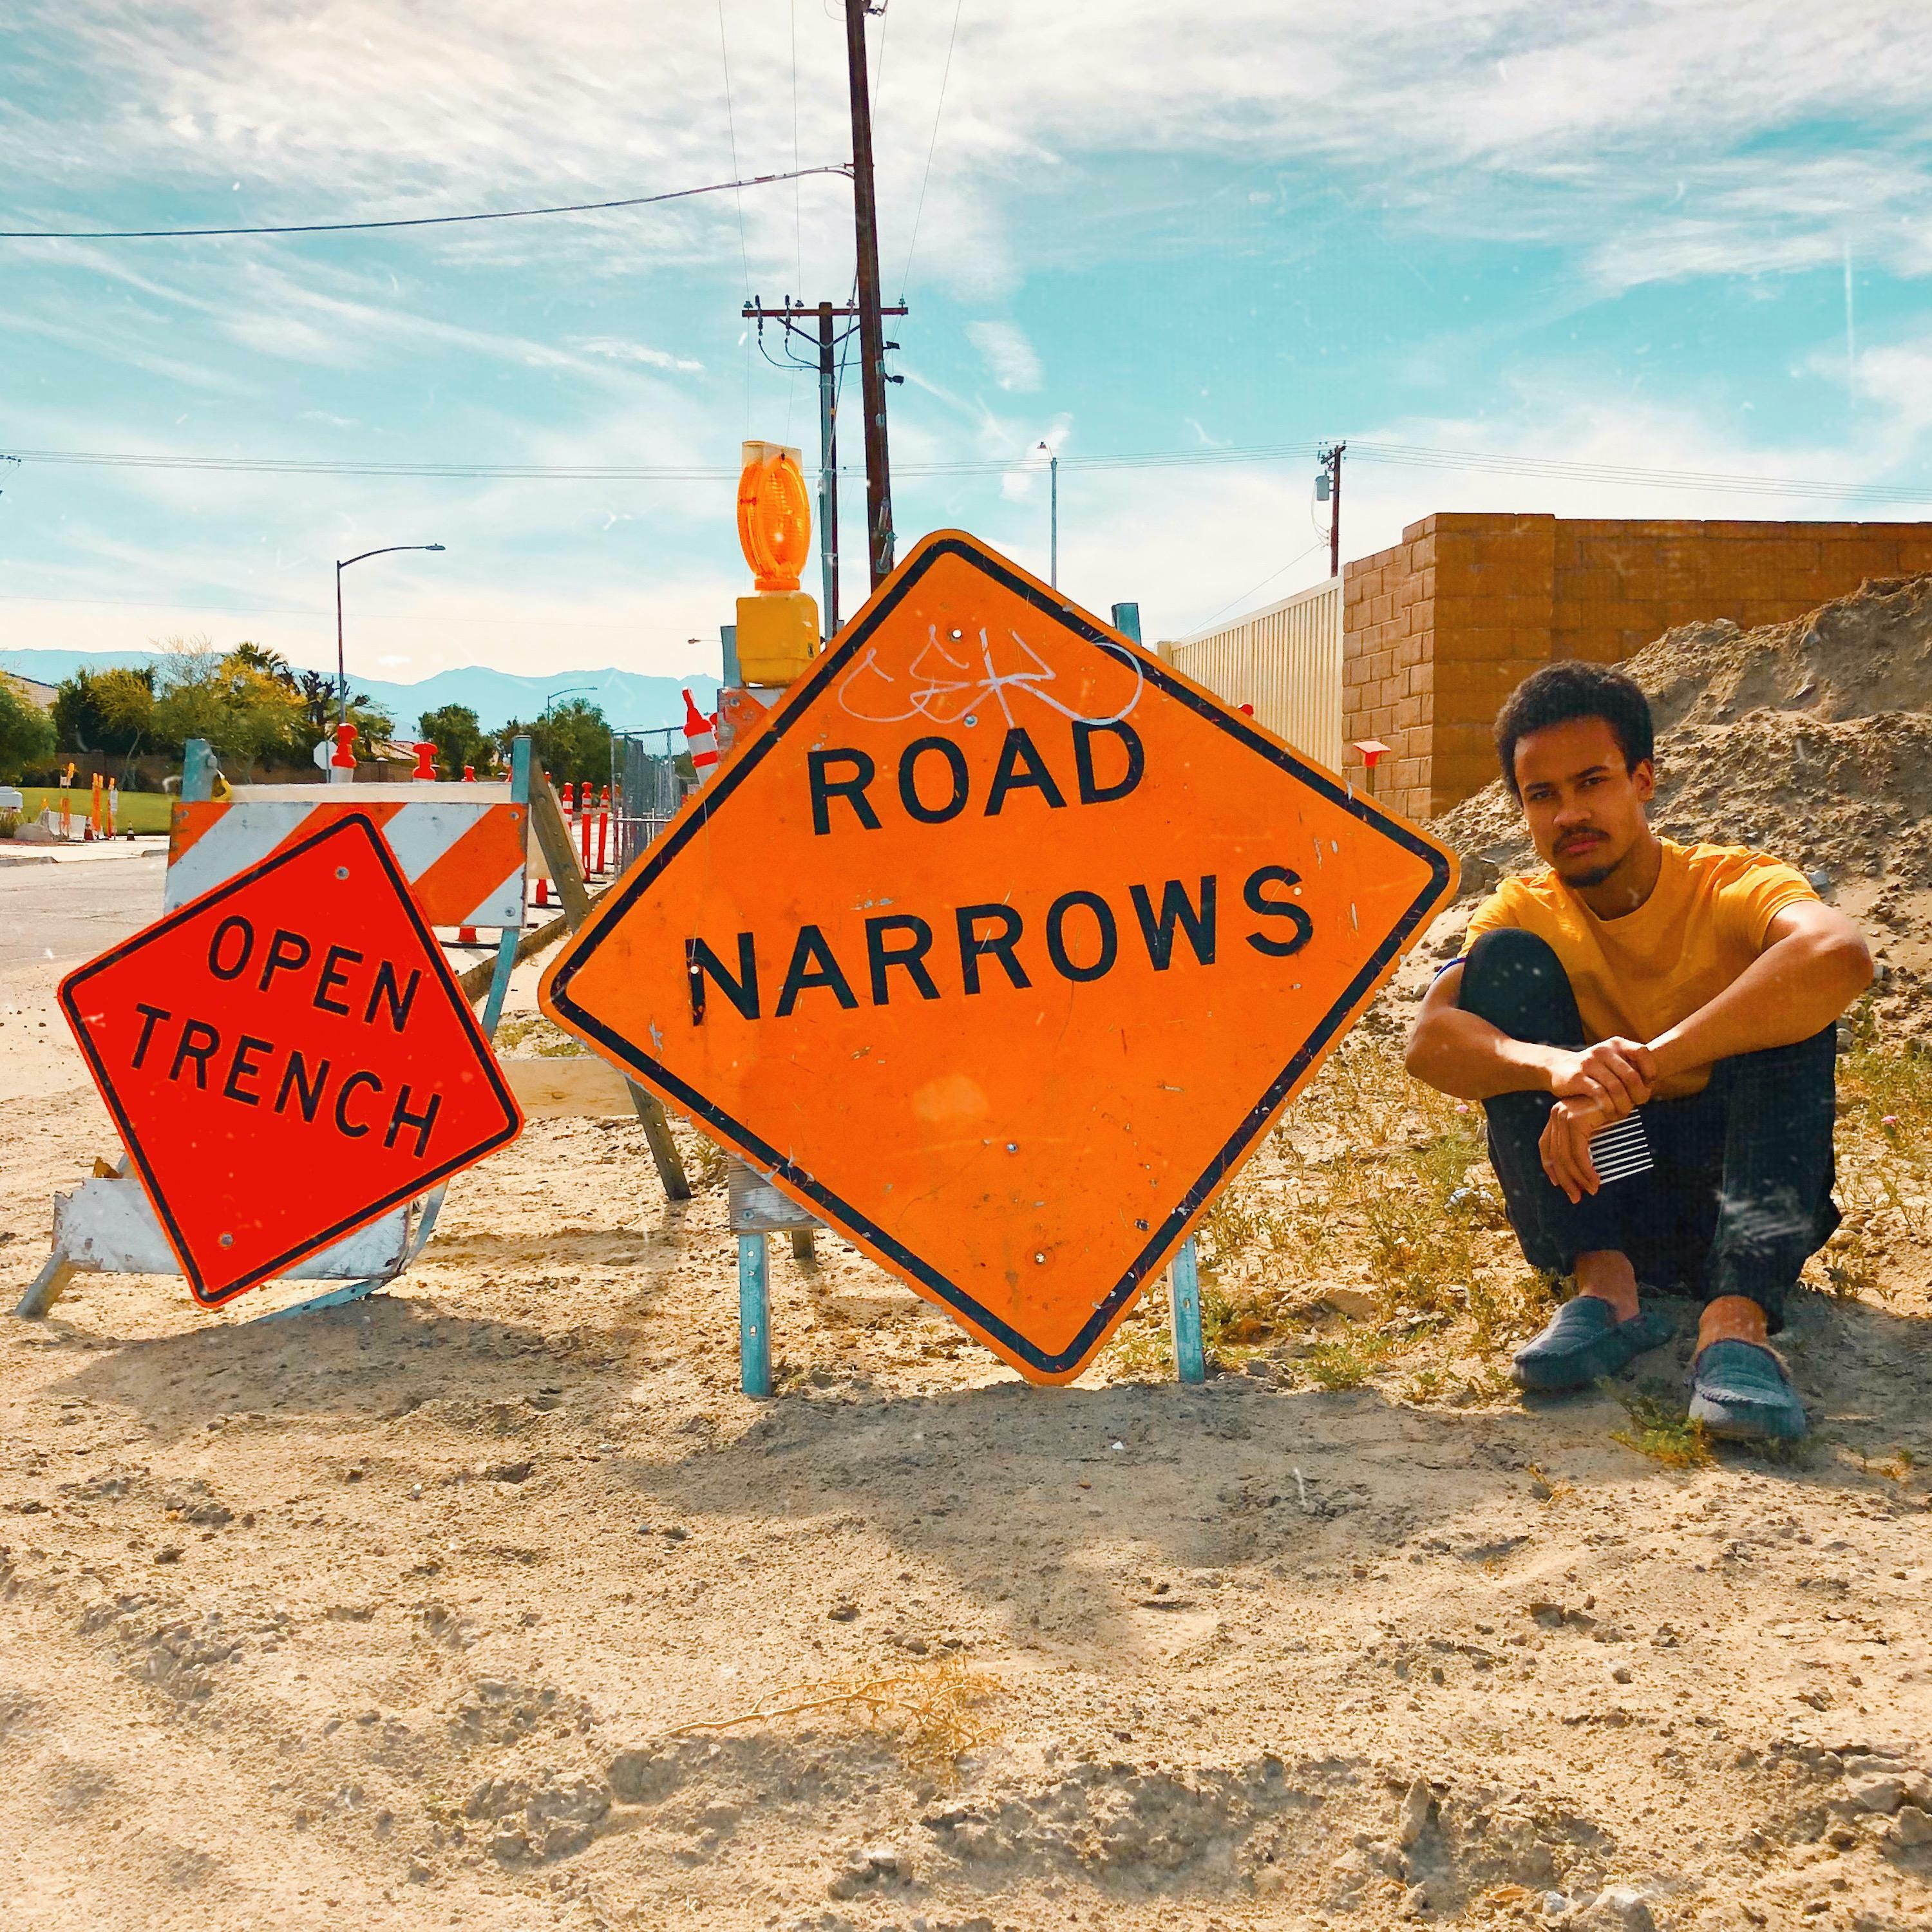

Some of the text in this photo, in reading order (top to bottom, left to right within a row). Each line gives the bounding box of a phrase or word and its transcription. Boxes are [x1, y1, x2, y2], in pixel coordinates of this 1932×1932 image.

[807, 716, 1145, 836] ROAD
[208, 916, 421, 1033] OPEN
[684, 865, 1314, 1027] NARROWS
[131, 1003, 442, 1159] TRENCH
